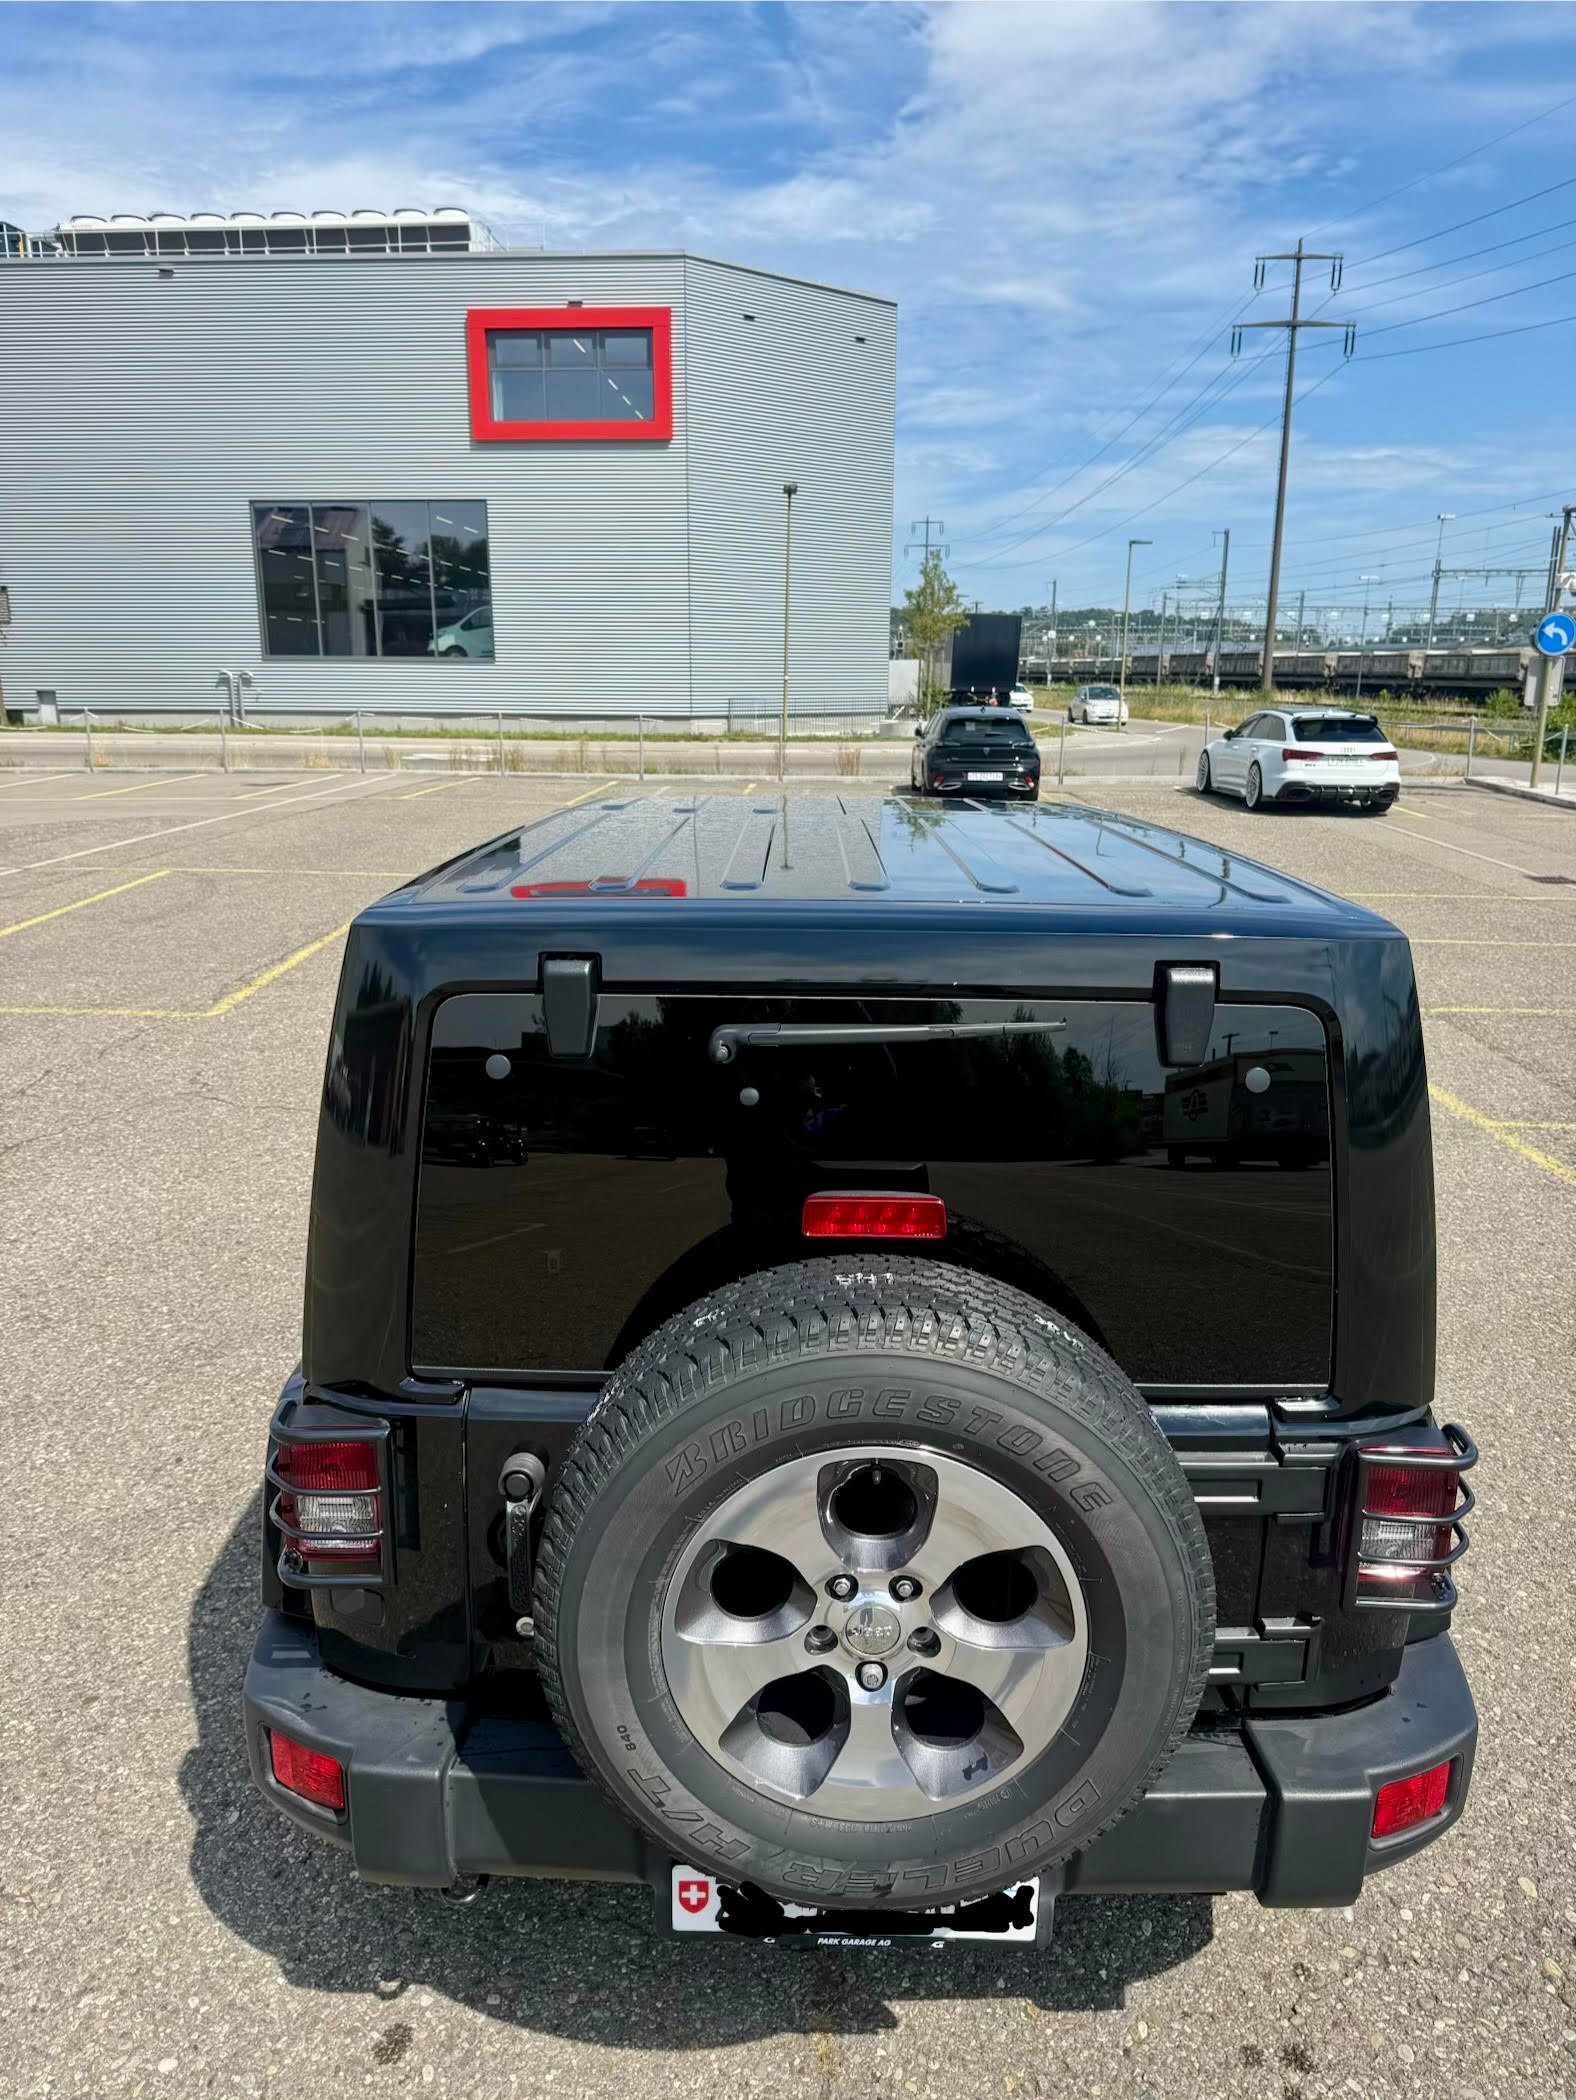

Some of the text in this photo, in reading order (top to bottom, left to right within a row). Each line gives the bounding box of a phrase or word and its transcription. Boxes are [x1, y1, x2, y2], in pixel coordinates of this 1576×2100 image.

[664, 1388, 1113, 1512] BRIDGESTONE
[782, 1778, 1101, 1893] DUELER
[817, 1937, 891, 1947] PARK GARAGE AG
